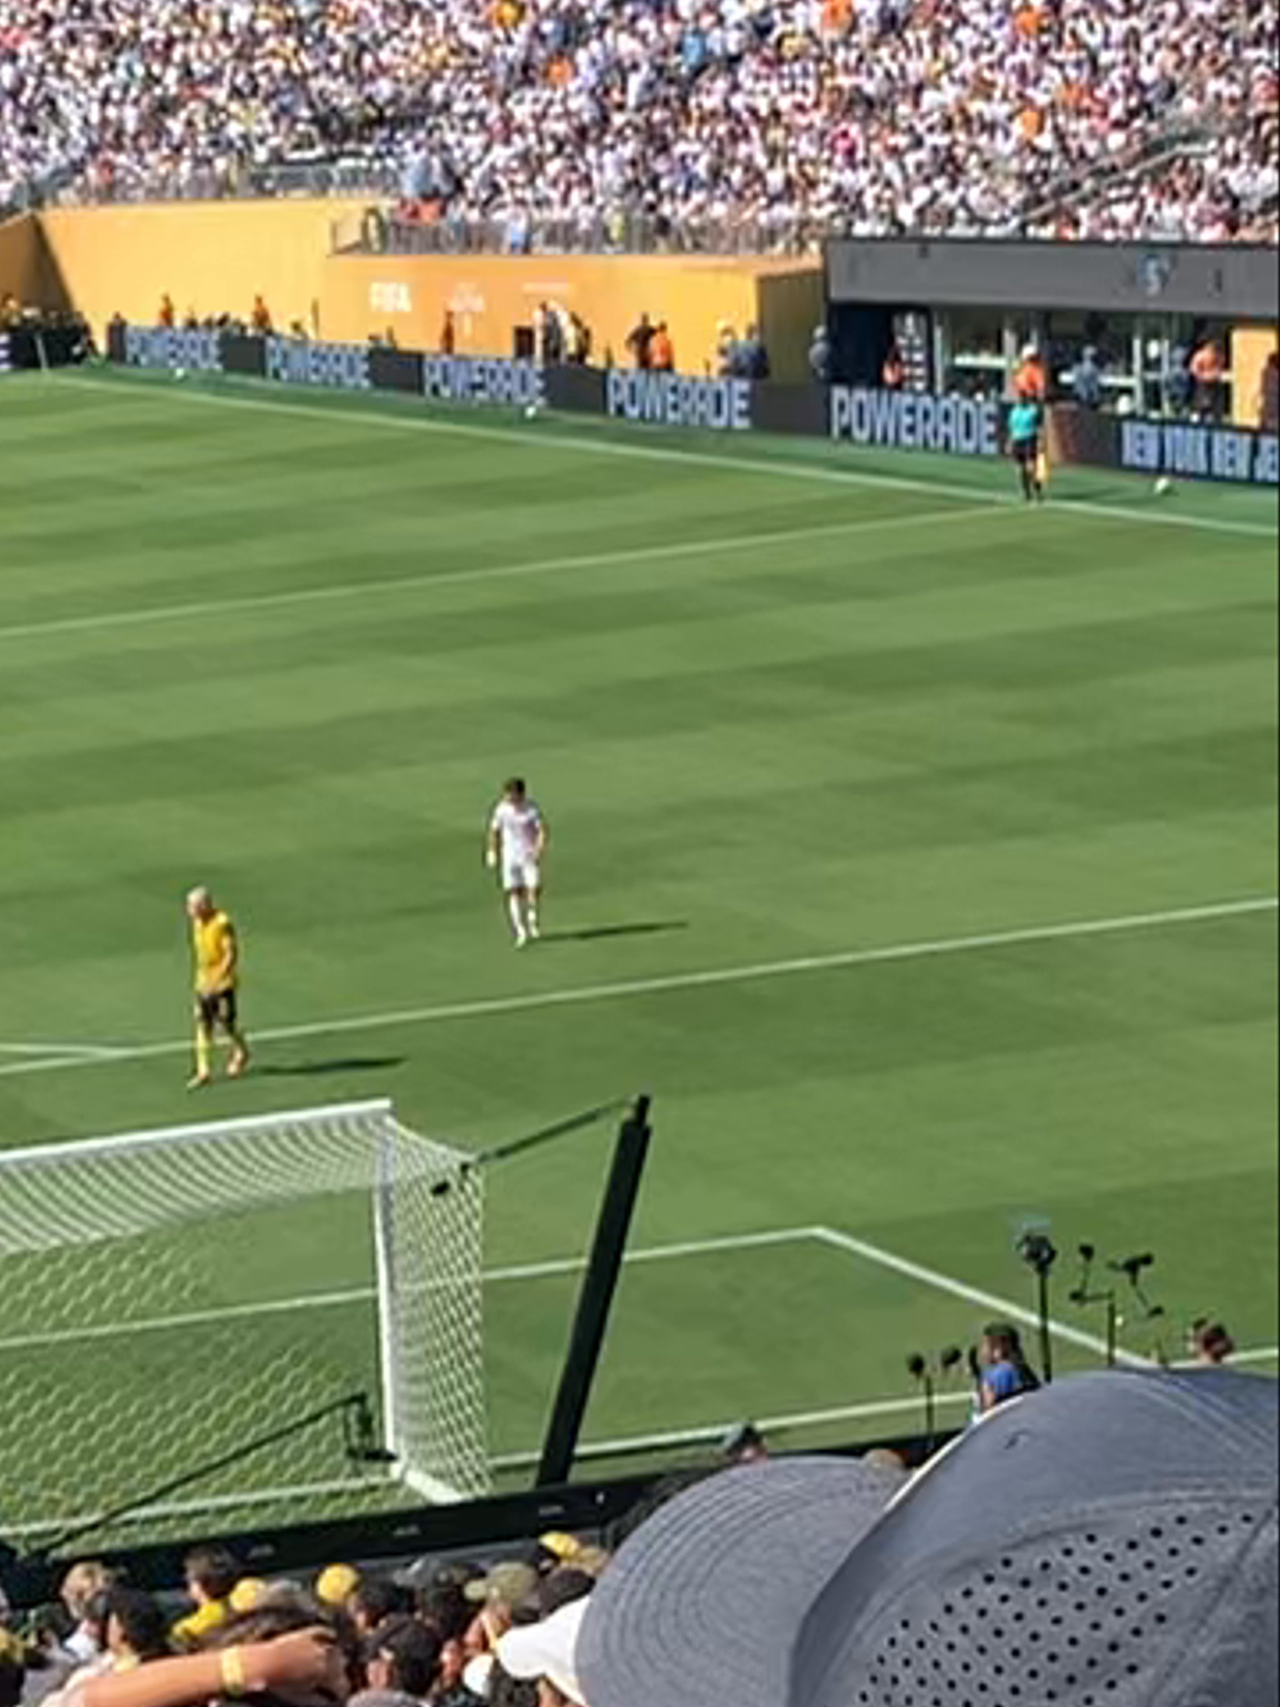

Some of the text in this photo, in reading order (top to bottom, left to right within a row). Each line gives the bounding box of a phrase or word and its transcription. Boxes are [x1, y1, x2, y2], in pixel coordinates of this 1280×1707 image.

[425, 354, 545, 405] POWERADE
[606, 370, 750, 428] POWERADE
[832, 392, 1000, 454] POWERADE
